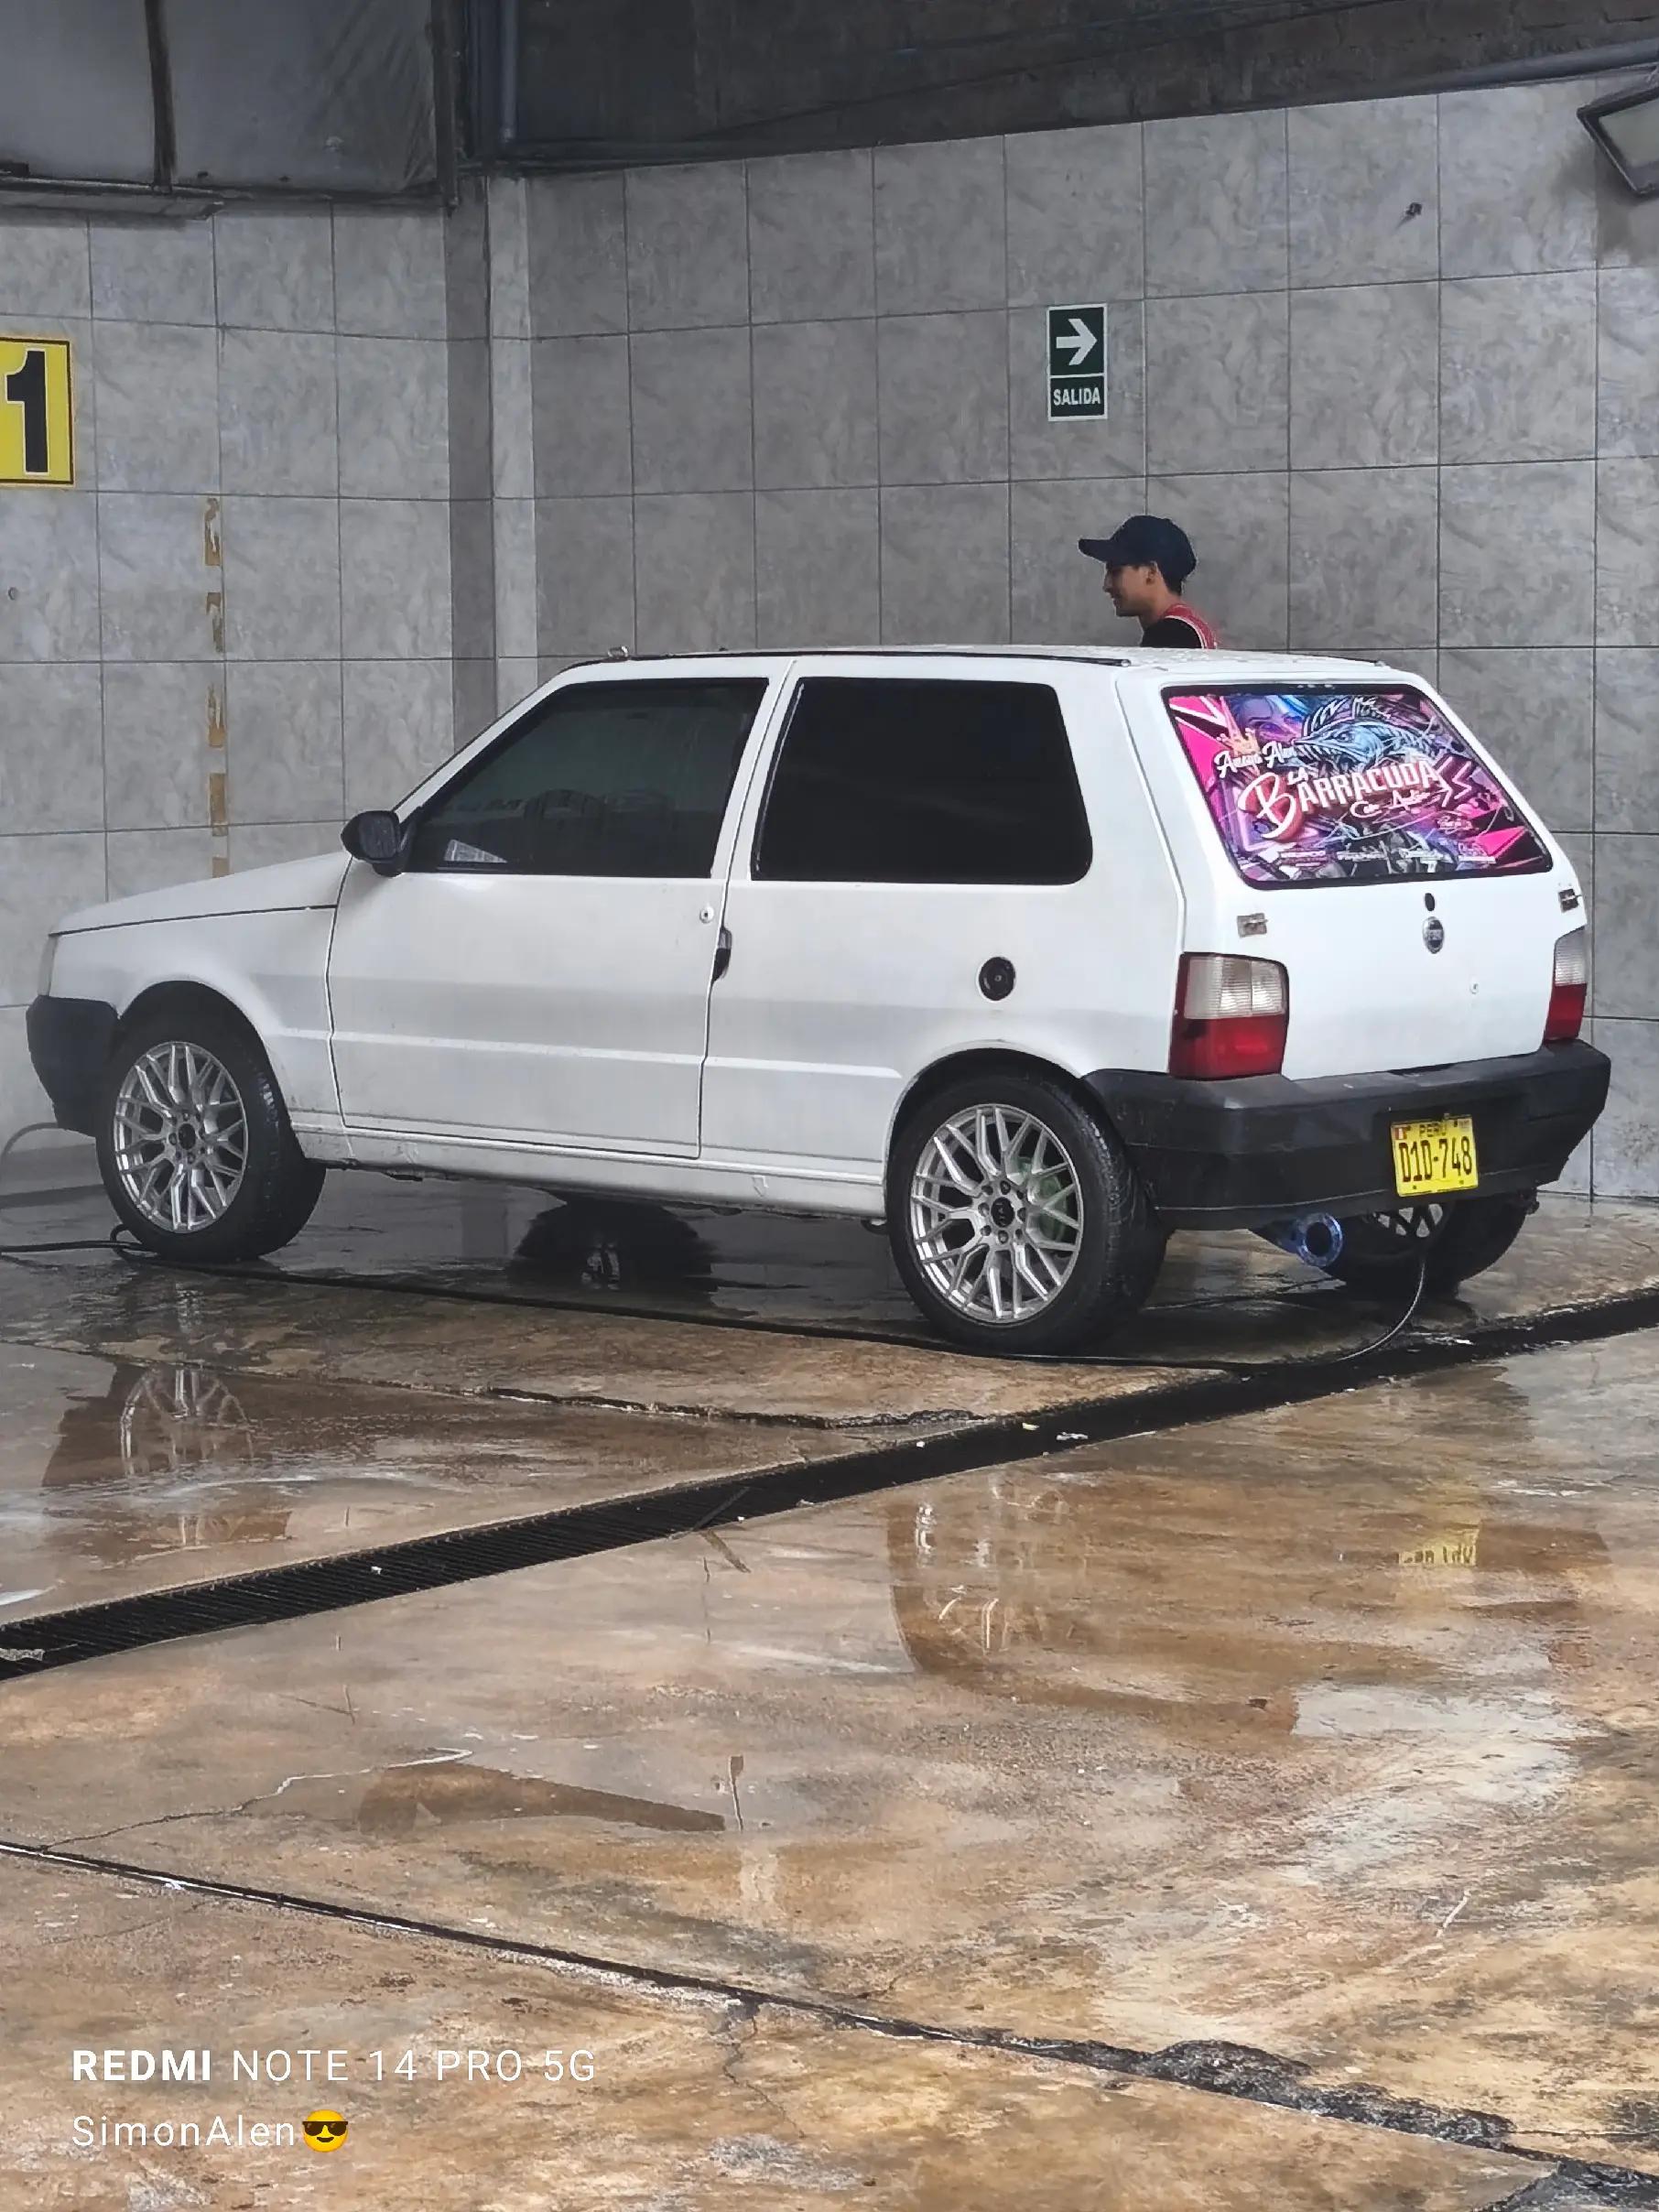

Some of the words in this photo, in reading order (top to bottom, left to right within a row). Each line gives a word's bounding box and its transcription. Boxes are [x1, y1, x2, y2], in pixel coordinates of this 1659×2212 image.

[5, 348, 49, 474] 1
[1053, 387, 1101, 406] SALIDA
[1238, 761, 1440, 840] BARRACUDA
[1398, 1135, 1473, 1183] D1D-748
